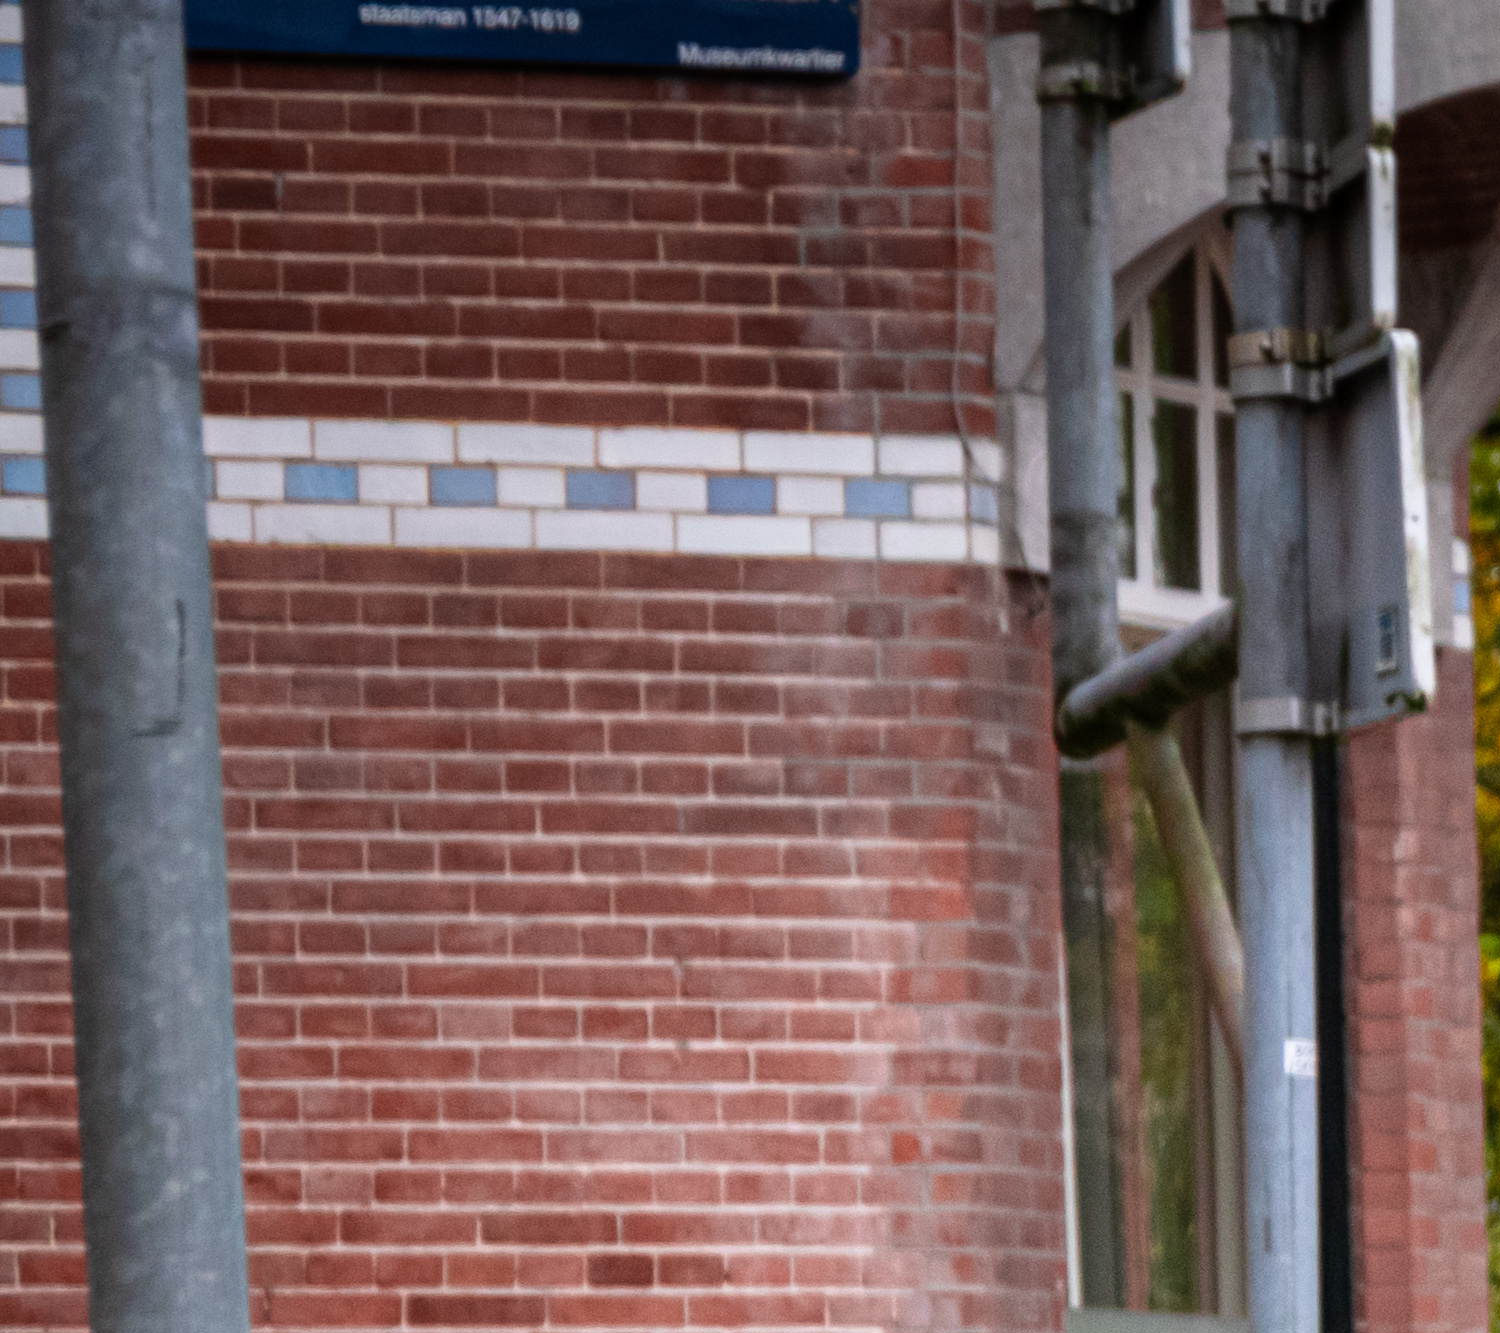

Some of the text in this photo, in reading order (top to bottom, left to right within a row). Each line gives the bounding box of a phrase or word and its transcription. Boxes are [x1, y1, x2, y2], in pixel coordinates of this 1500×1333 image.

[359, 5, 580, 32] staatsman 1547-1619
[677, 41, 845, 71] Museumkwartier
